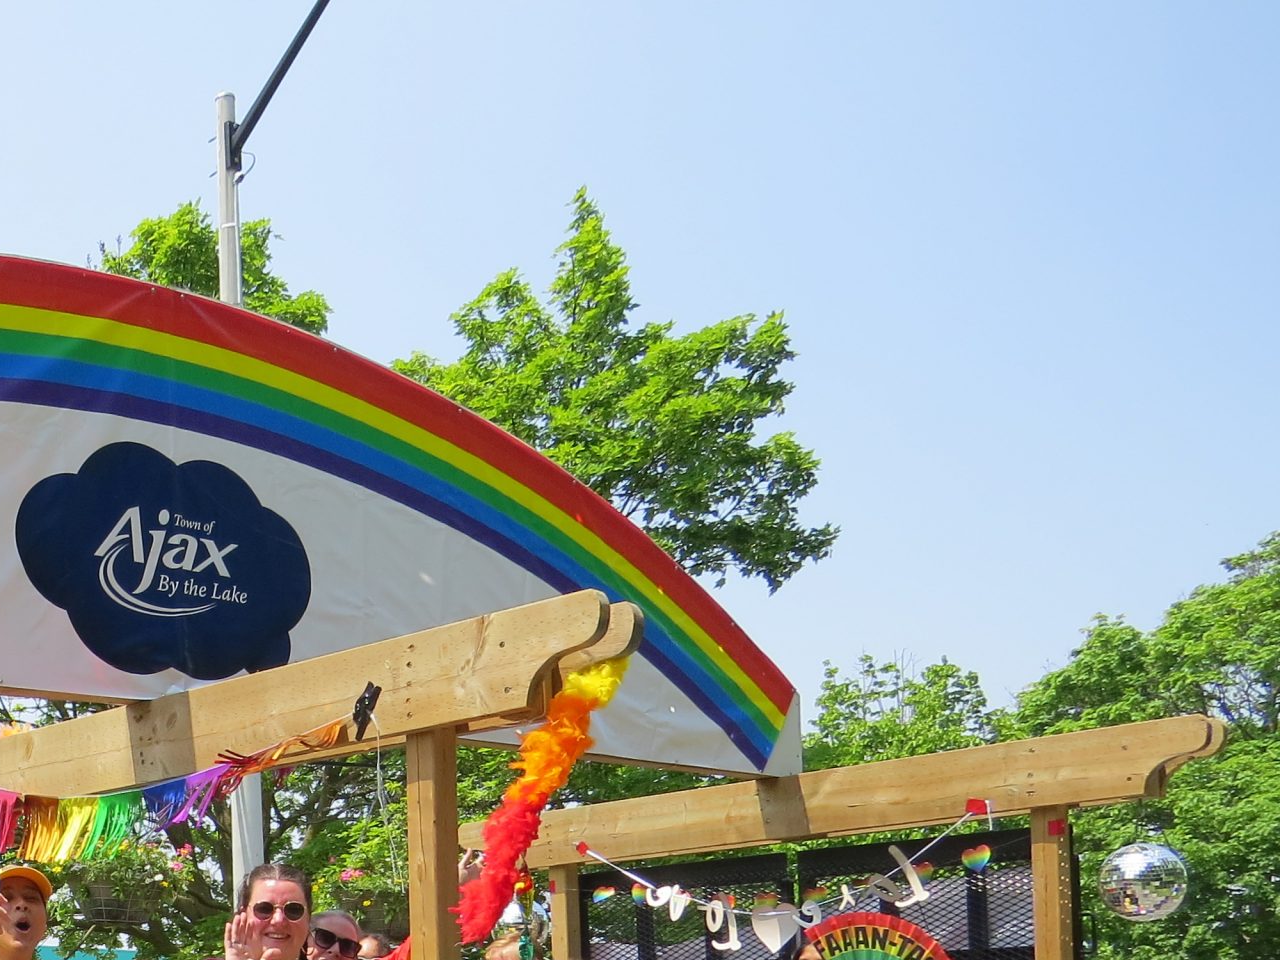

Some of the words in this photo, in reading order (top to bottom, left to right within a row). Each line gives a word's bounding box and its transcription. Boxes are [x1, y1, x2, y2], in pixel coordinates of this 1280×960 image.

[173, 513, 202, 531] Town
[202, 520, 216, 535] of
[94, 505, 239, 595] Ajax
[156, 574, 180, 597] By
[183, 579, 208, 598] the
[211, 582, 249, 604] Lake
